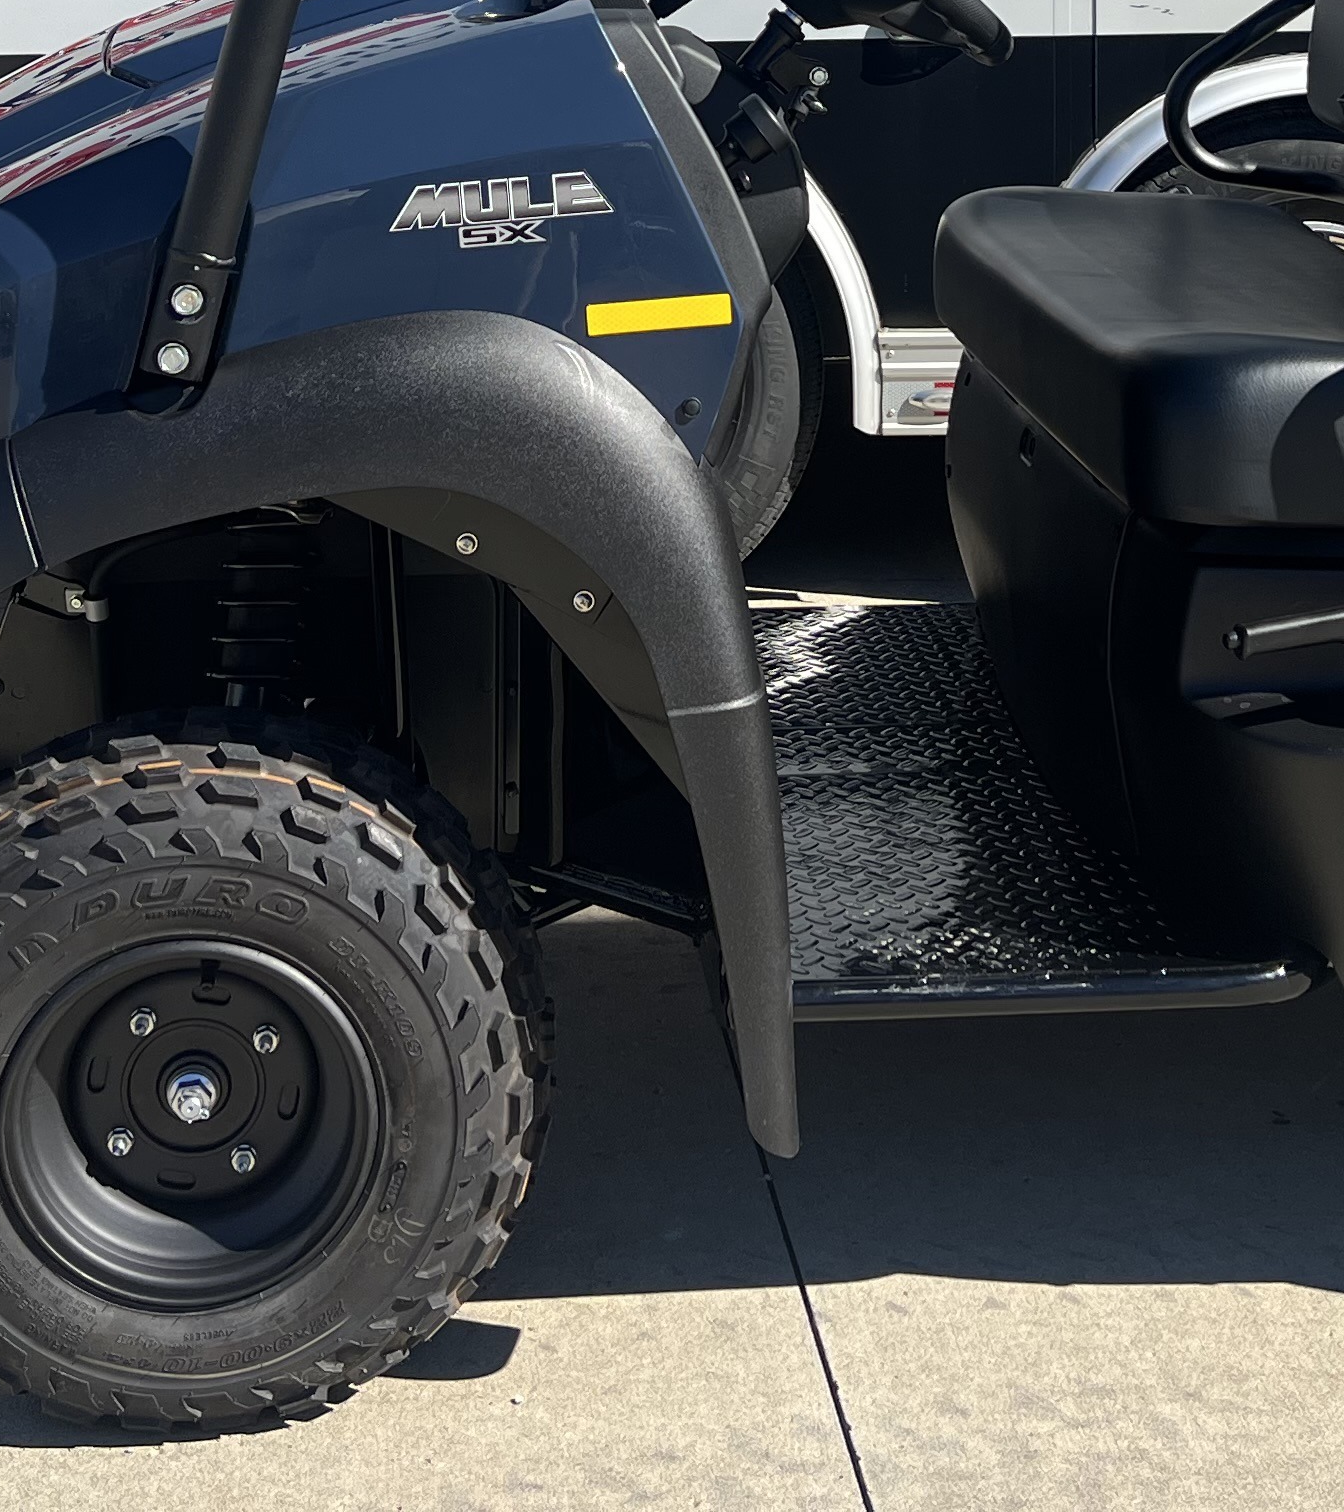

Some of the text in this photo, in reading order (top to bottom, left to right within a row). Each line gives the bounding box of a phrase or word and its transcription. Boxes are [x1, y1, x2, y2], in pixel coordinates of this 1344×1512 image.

[389, 171, 614, 232] MULE
[458, 219, 546, 249] SX
[72, 874, 310, 931] DURO
